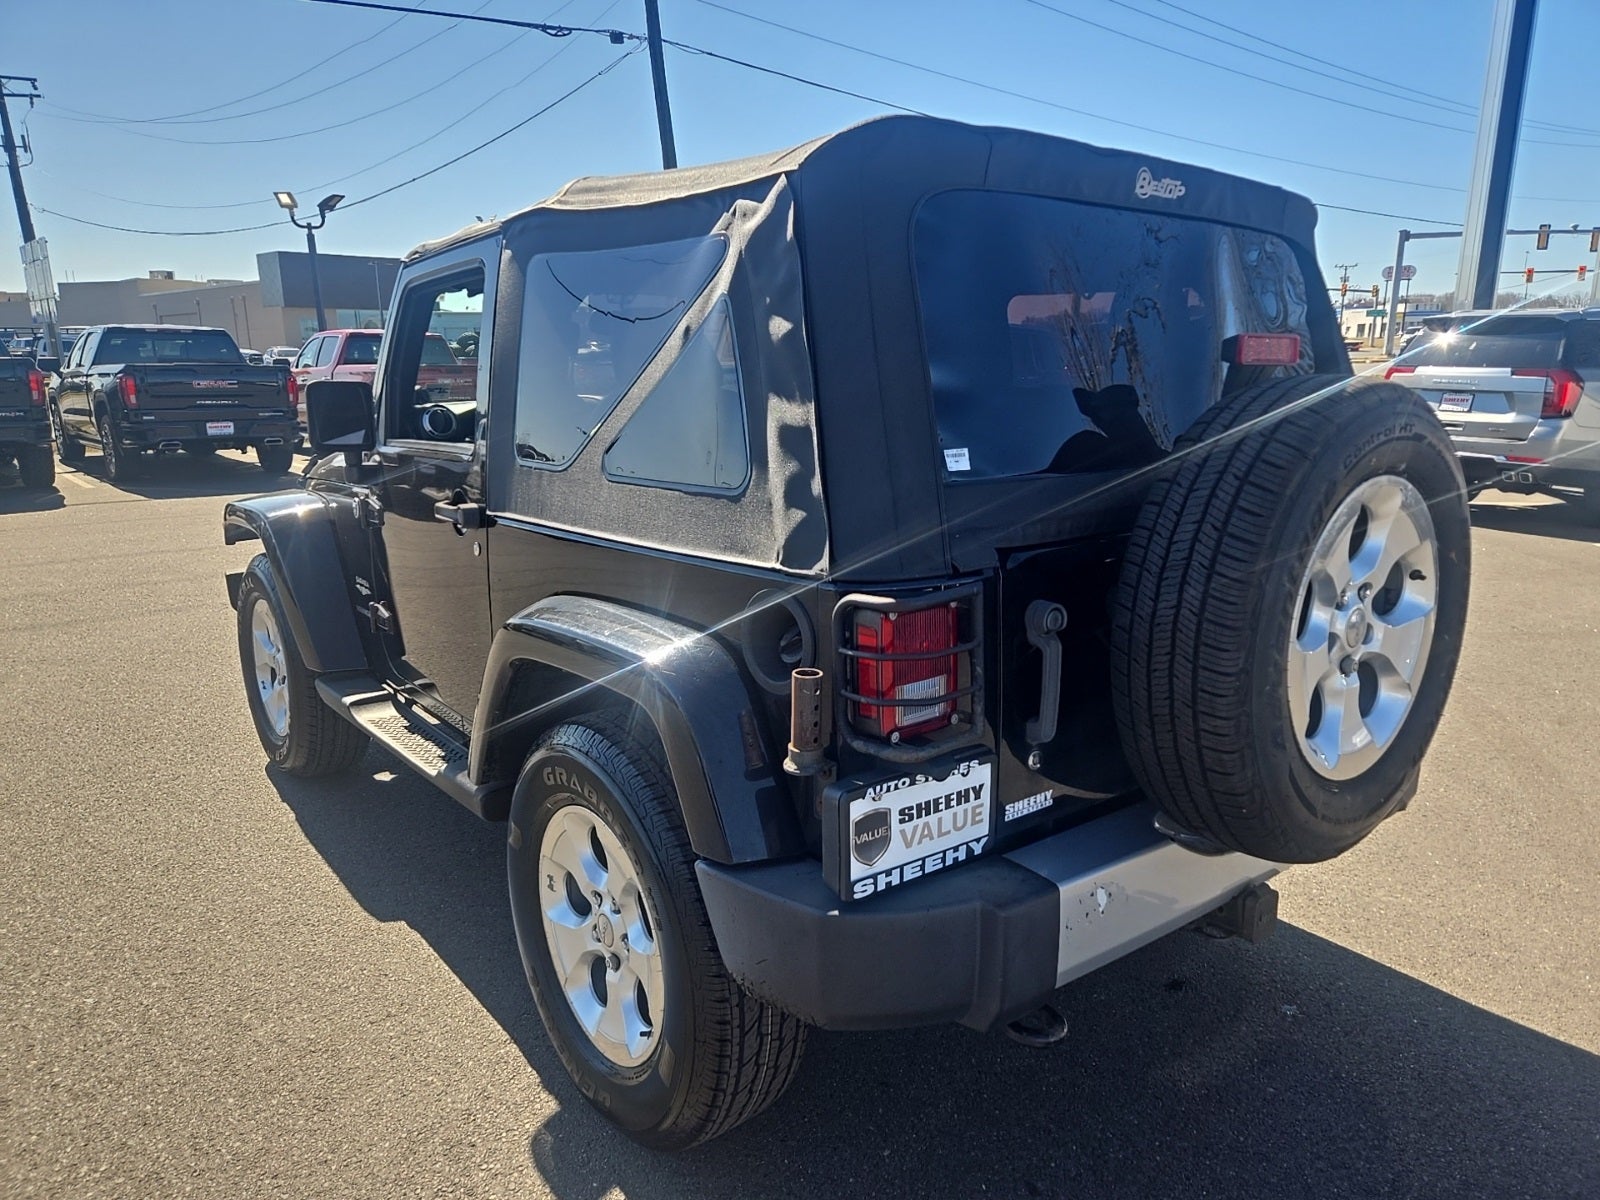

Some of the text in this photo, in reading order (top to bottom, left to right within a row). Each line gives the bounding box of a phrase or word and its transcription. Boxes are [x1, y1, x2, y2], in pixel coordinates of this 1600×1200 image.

[864, 777, 911, 800] AUTO
[898, 783, 985, 825] SHEEHY
[1004, 789, 1053, 815] SHEEHY
[853, 826, 889, 845] VALUE
[899, 802, 985, 849] VALUE
[853, 836, 990, 900] SHEEHY
